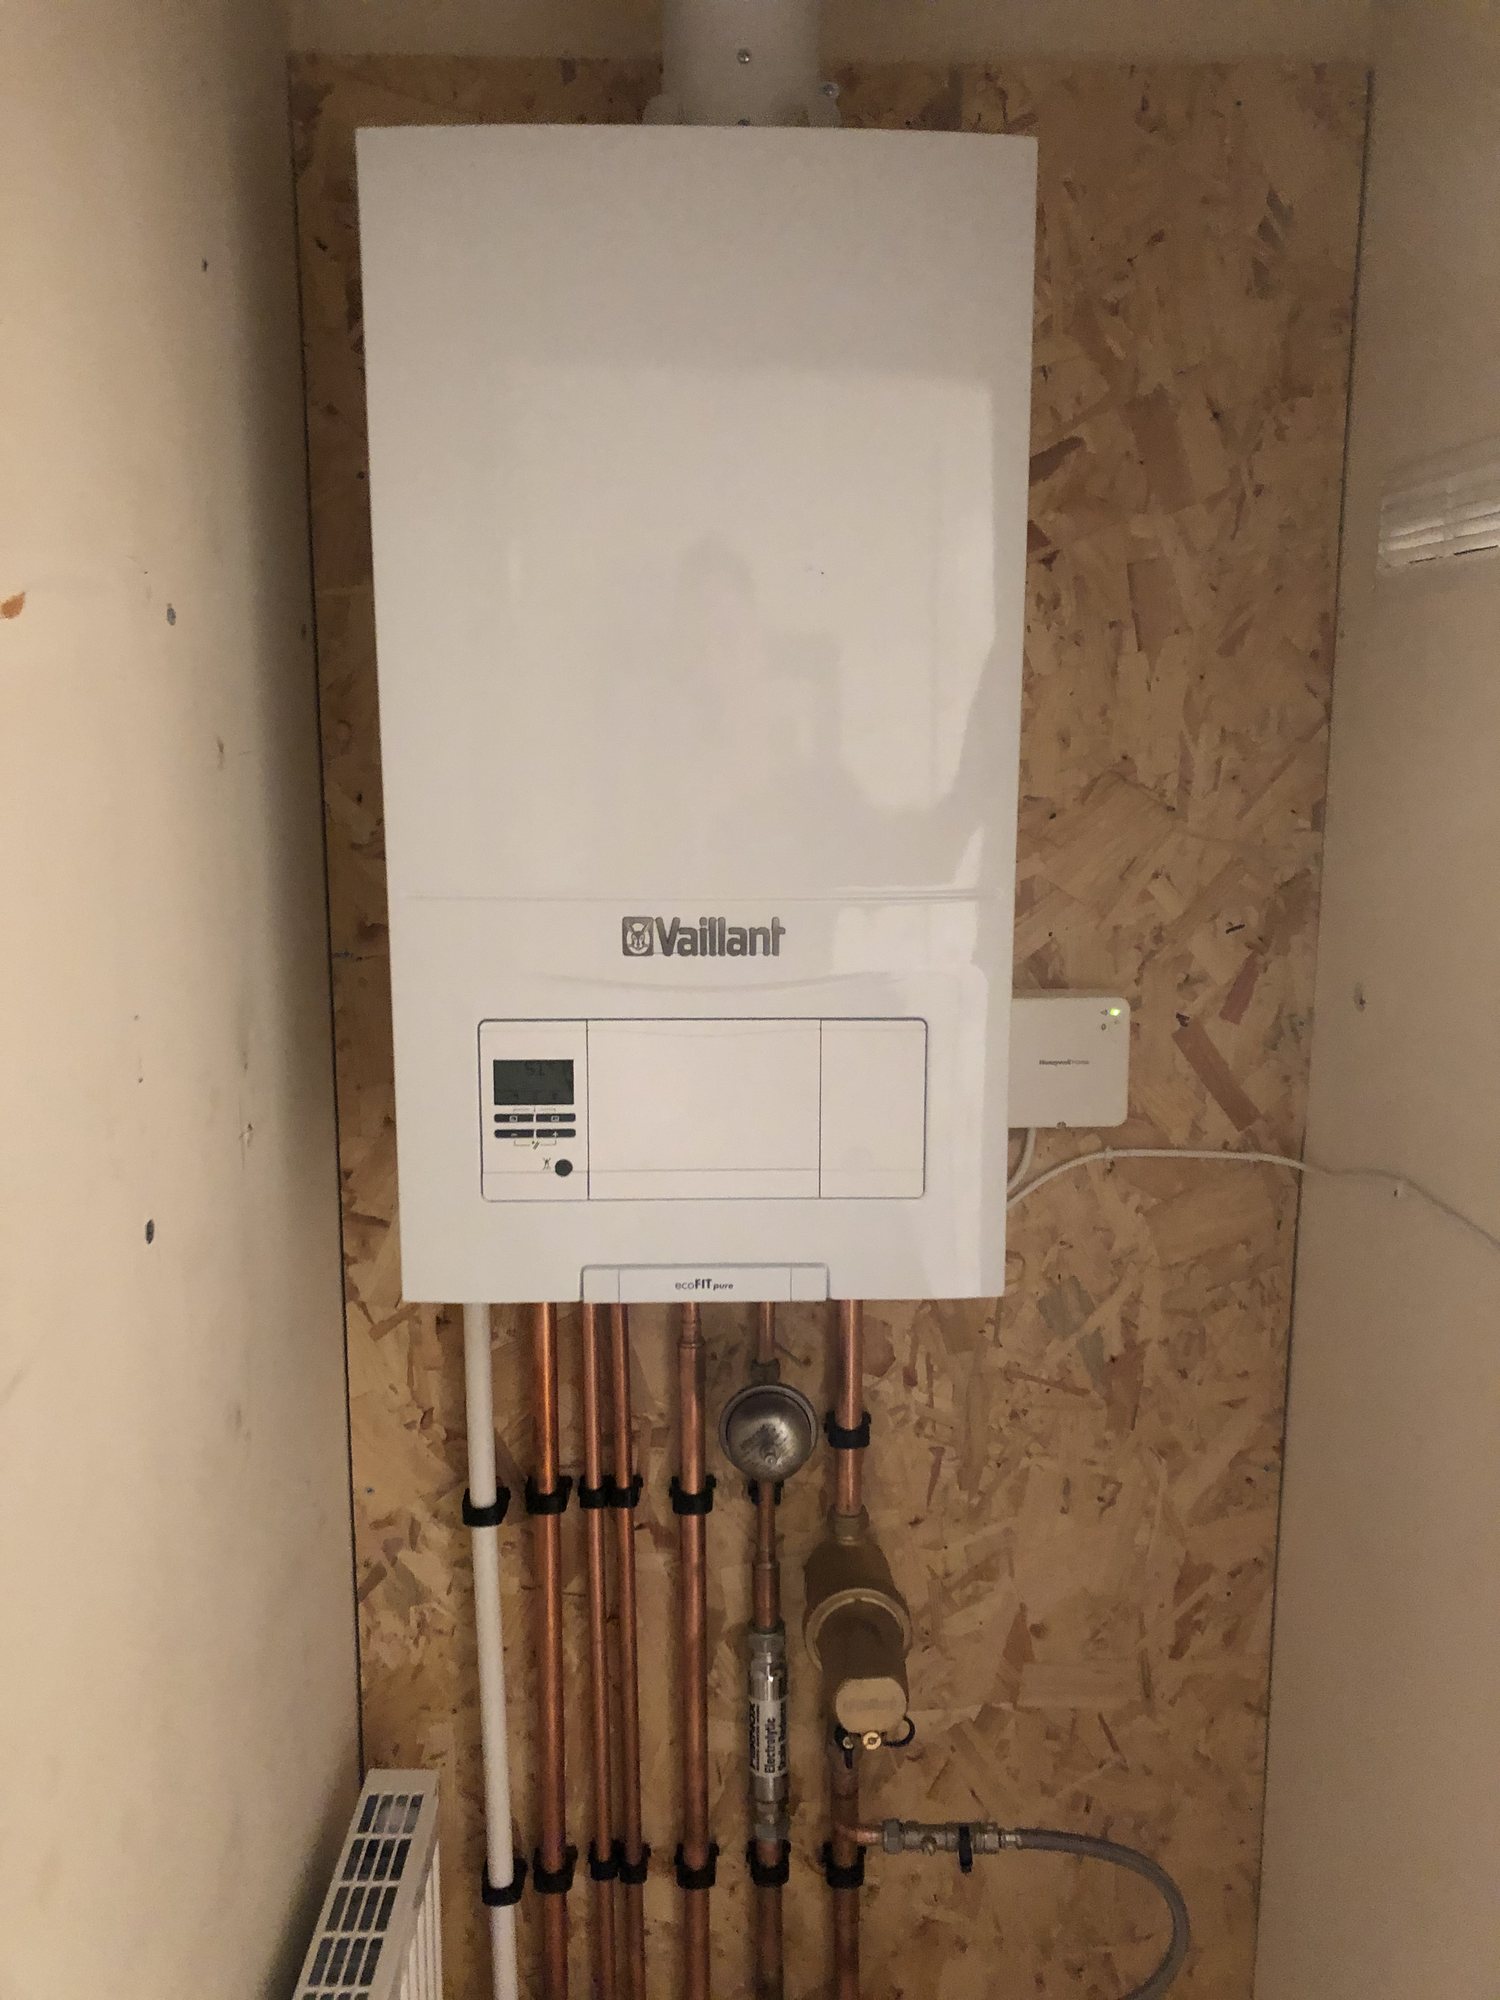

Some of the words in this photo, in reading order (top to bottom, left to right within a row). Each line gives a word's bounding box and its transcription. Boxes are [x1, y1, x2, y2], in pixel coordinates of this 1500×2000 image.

[654, 917, 786, 957] Vaillant
[675, 1278, 712, 1290] ecoFIT
[713, 1283, 734, 1291] pure
[764, 1718, 777, 1774] Electrolytic
